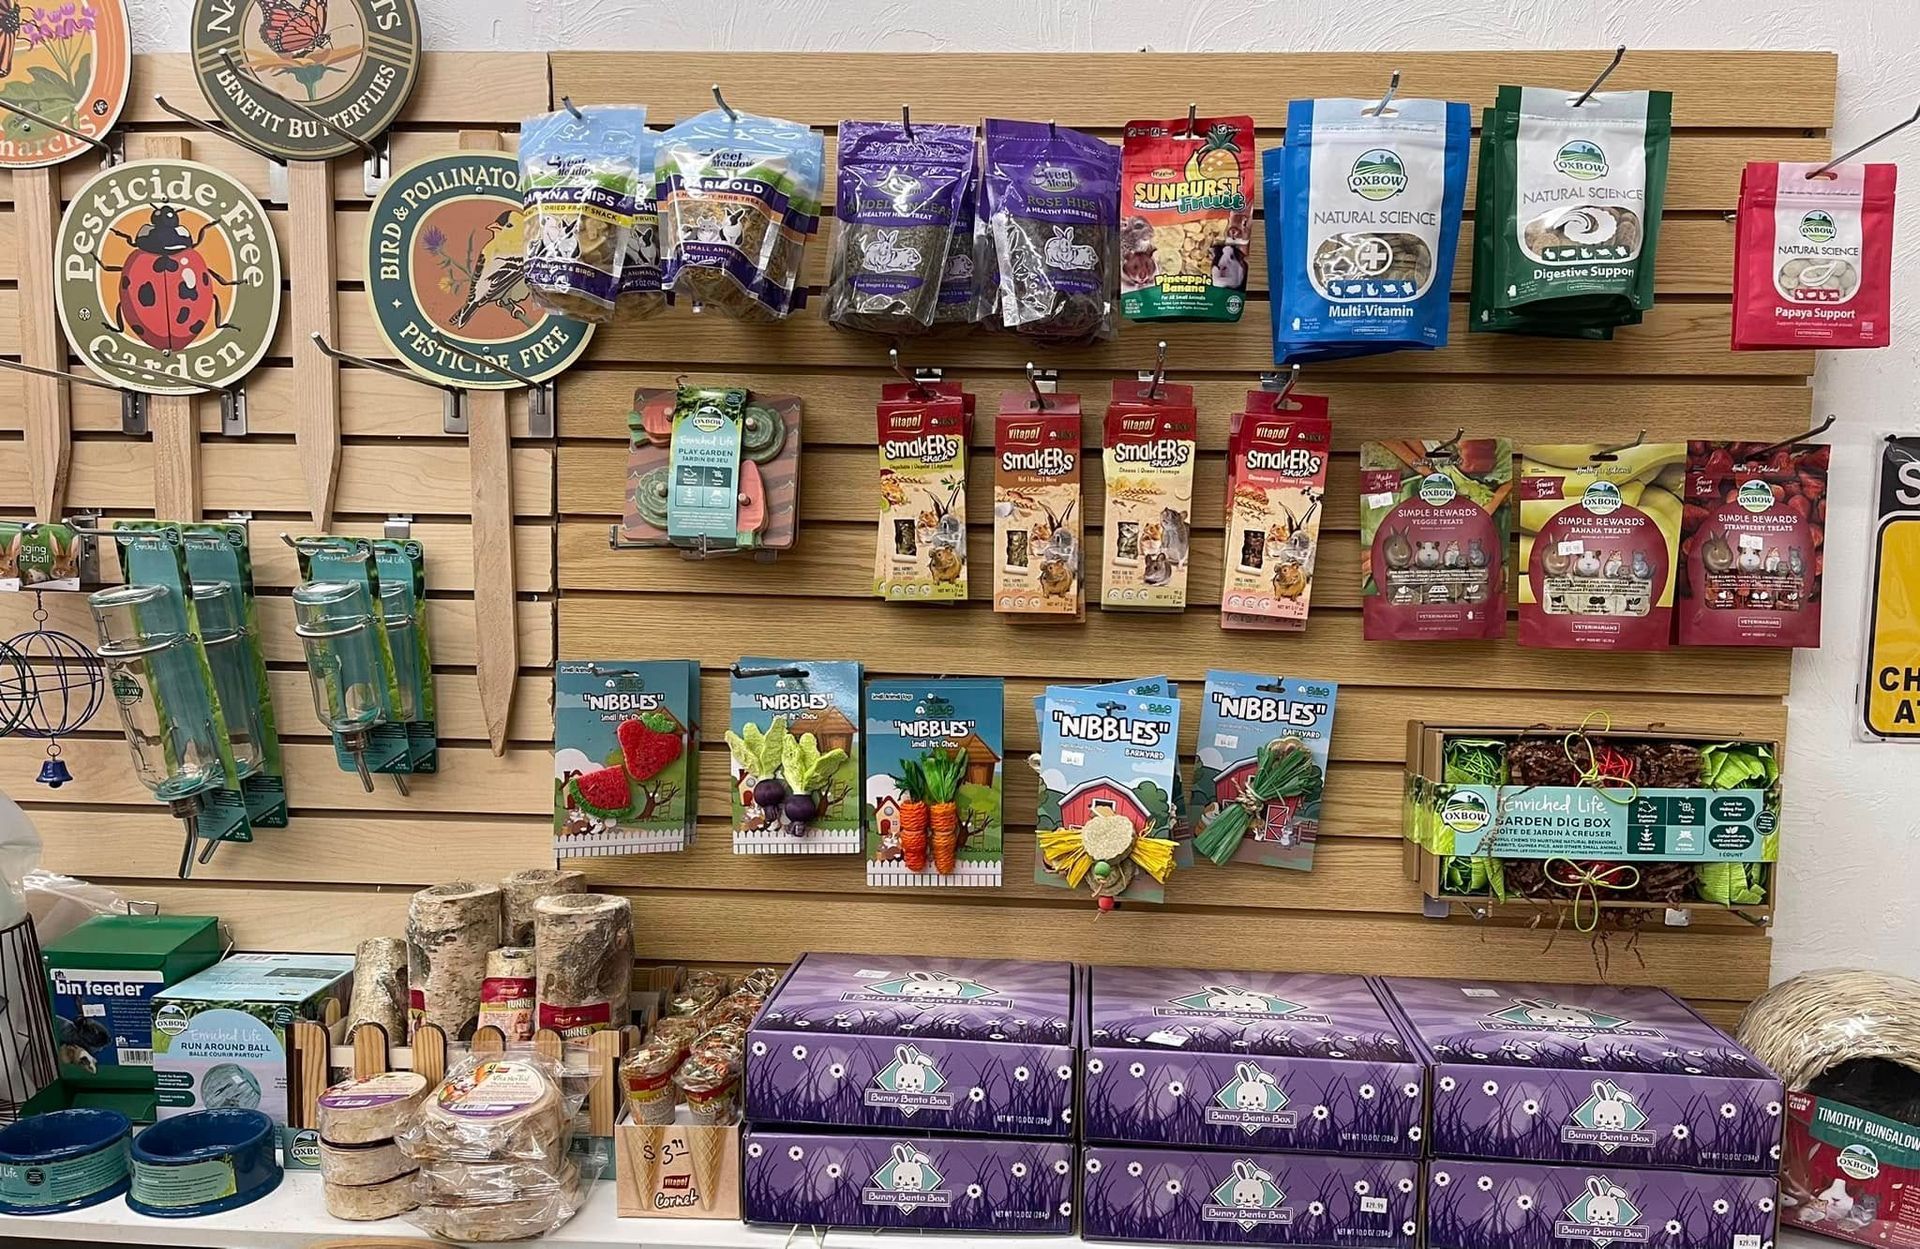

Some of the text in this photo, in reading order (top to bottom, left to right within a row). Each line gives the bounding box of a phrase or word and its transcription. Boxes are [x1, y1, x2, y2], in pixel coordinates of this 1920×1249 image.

[216, 64, 396, 138] BENEFIT BUTTERFLIES
[1558, 161, 1605, 173] OXBOW
[1352, 175, 1403, 187] OXBOW
[1135, 178, 1241, 201] SUNBURST
[1523, 187, 1643, 204] NATURAL SCIENCE
[1028, 195, 1096, 211] ROSE HIPS
[1177, 192, 1246, 213] Fruit
[591, 208, 617, 220] SNACK
[1314, 211, 1436, 226] NATURAL SCIENCE
[1802, 226, 1834, 235] OXBOW
[380, 222, 403, 281] BIRD
[392, 206, 409, 221] &
[1778, 245, 1859, 256] NATURAL SCIENCE
[1533, 266, 1588, 280] Digestive
[1156, 275, 1212, 286] Pineapple
[1162, 283, 1205, 293] Banana
[1328, 305, 1414, 317] Multi-Vitamin
[1775, 306, 1856, 319] Papaya Support
[400, 321, 570, 374] PESTICIDE FREE
[89, 334, 245, 382] Garden
[694, 418, 723, 426] OXBOW
[678, 447, 733, 457] PLAY GARDEN
[1421, 489, 1454, 497] OXBOW
[1584, 498, 1620, 507] OXBOW
[1739, 496, 1773, 505] OXBOW
[1398, 508, 1478, 518] SIMPLE REWARDS
[1718, 514, 1798, 524] SIMPLE REWARDS
[1558, 517, 1645, 526] SIMPLE REWARDS
[1724, 523, 1766, 532] STRAWBERRY
[1603, 527, 1631, 535] TREATS
[31, 553, 50, 563] ball
[584, 693, 664, 711] "NIBBLES"
[754, 693, 834, 710] "NIBBLES"
[1212, 693, 1327, 727] "NIBBLES"
[893, 720, 975, 738] "NIBBLES"
[1053, 710, 1170, 747] "NIBBLES"
[911, 740, 959, 749] Small Pet Chew
[1125, 748, 1165, 760] BARNYARD
[1501, 794, 1571, 815] Enriched
[1444, 811, 1488, 822] OXBOW
[1557, 818, 1580, 828] DIG
[1583, 818, 1612, 828] BOX
[1533, 829, 1563, 837] JARDIN
[56, 981, 144, 997] bin feeder
[852, 994, 1003, 1007] Bunny Bento Box
[1164, 1007, 1320, 1022] Bunny Bento Box
[156, 1020, 188, 1028] OXBOW
[181, 1042, 271, 1052] RUN AROUND BALL
[871, 1093, 948, 1105] Bunny Bento Box
[1789, 1101, 1807, 1111] CLUB
[1211, 1111, 1291, 1124] Bunny Bento Box
[1817, 1106, 1864, 1133] TIMOTHY
[1864, 1119, 1920, 1152] BUNGALOW
[1568, 1130, 1650, 1143] Bunny Bento Box
[1838, 1156, 1879, 1175] OXBOW
[655, 1190, 699, 1208] Cornet
[868, 1192, 946, 1203] Bunny Bento Box
[1208, 1208, 1288, 1220] Bunny Bento Box
[1561, 1225, 1643, 1238] Bunny Bento Box
